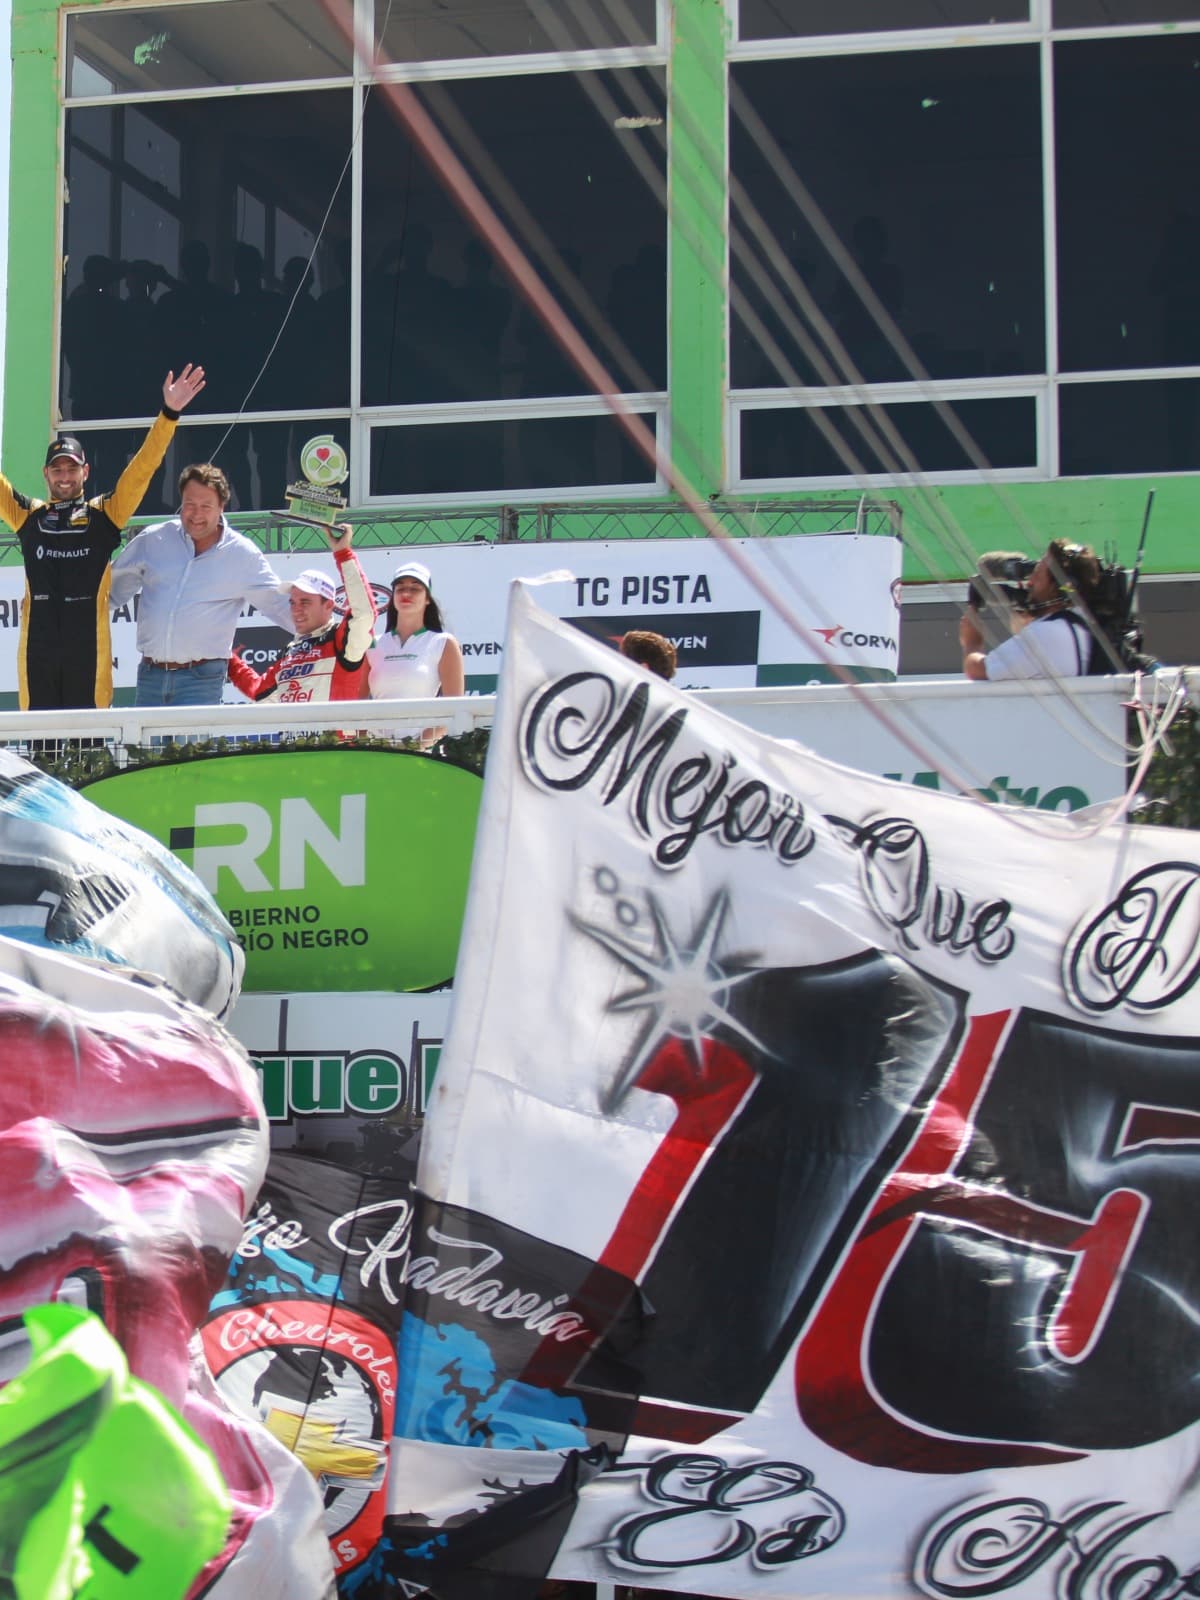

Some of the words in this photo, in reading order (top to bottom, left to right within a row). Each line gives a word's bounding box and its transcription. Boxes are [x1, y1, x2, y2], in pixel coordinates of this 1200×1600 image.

[46, 548, 90, 559] RENAULT
[574, 577, 609, 607] TC
[622, 575, 712, 605] PISTA
[462, 641, 503, 656] RVEN
[524, 670, 816, 866] Mejor
[823, 815, 1016, 962] Que
[192, 793, 366, 895] RN
[225, 904, 320, 928] BIERNO
[282, 927, 368, 950] NEGRO
[251, 1053, 402, 1121] que
